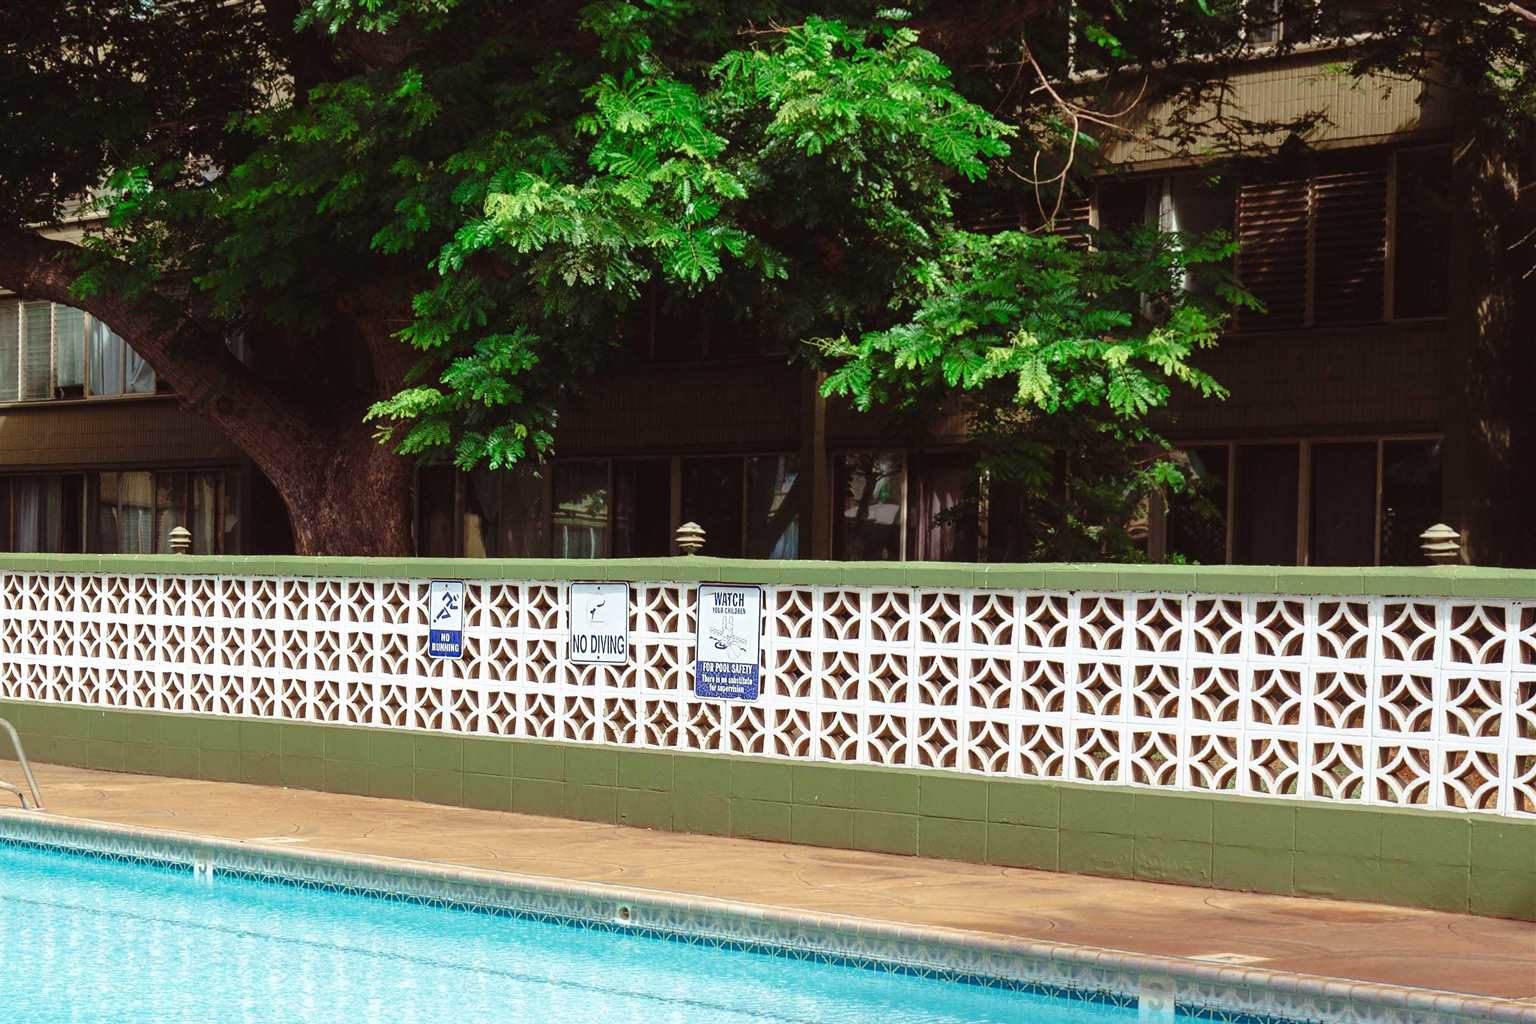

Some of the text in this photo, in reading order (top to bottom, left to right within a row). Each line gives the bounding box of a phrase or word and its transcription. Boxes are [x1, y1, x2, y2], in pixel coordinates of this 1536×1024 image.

[714, 592, 745, 607] WATCH
[440, 633, 450, 642] NO
[573, 634, 625, 654] NO DIVING
[703, 662, 753, 675] FOR POOL SAFETY
